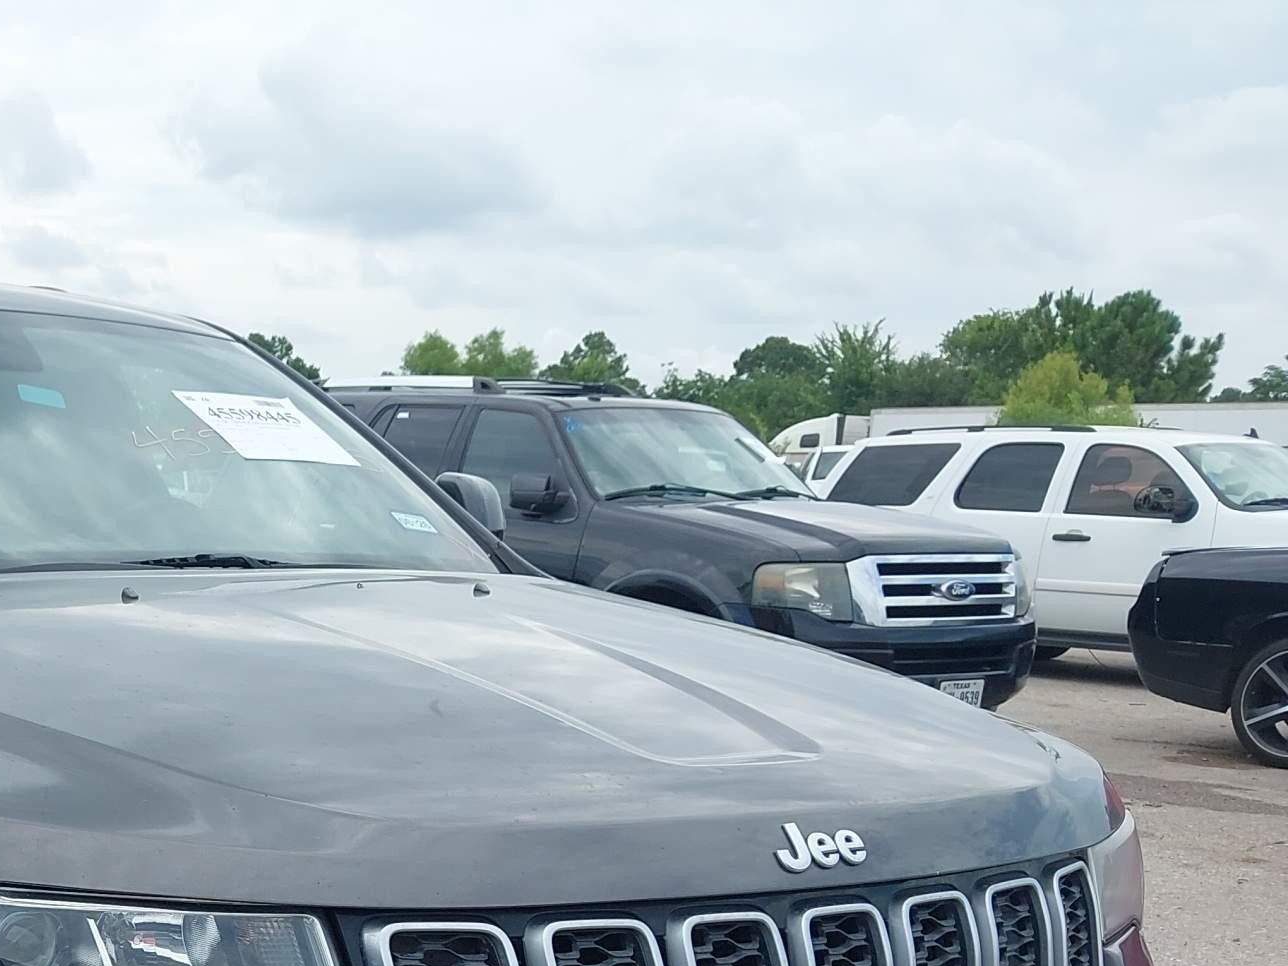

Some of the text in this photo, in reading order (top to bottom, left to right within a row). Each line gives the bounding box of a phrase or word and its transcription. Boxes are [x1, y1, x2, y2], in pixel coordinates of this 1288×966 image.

[207, 406, 302, 425] 45598445
[953, 682, 971, 690] TEXAS
[774, 822, 868, 873] Jee
